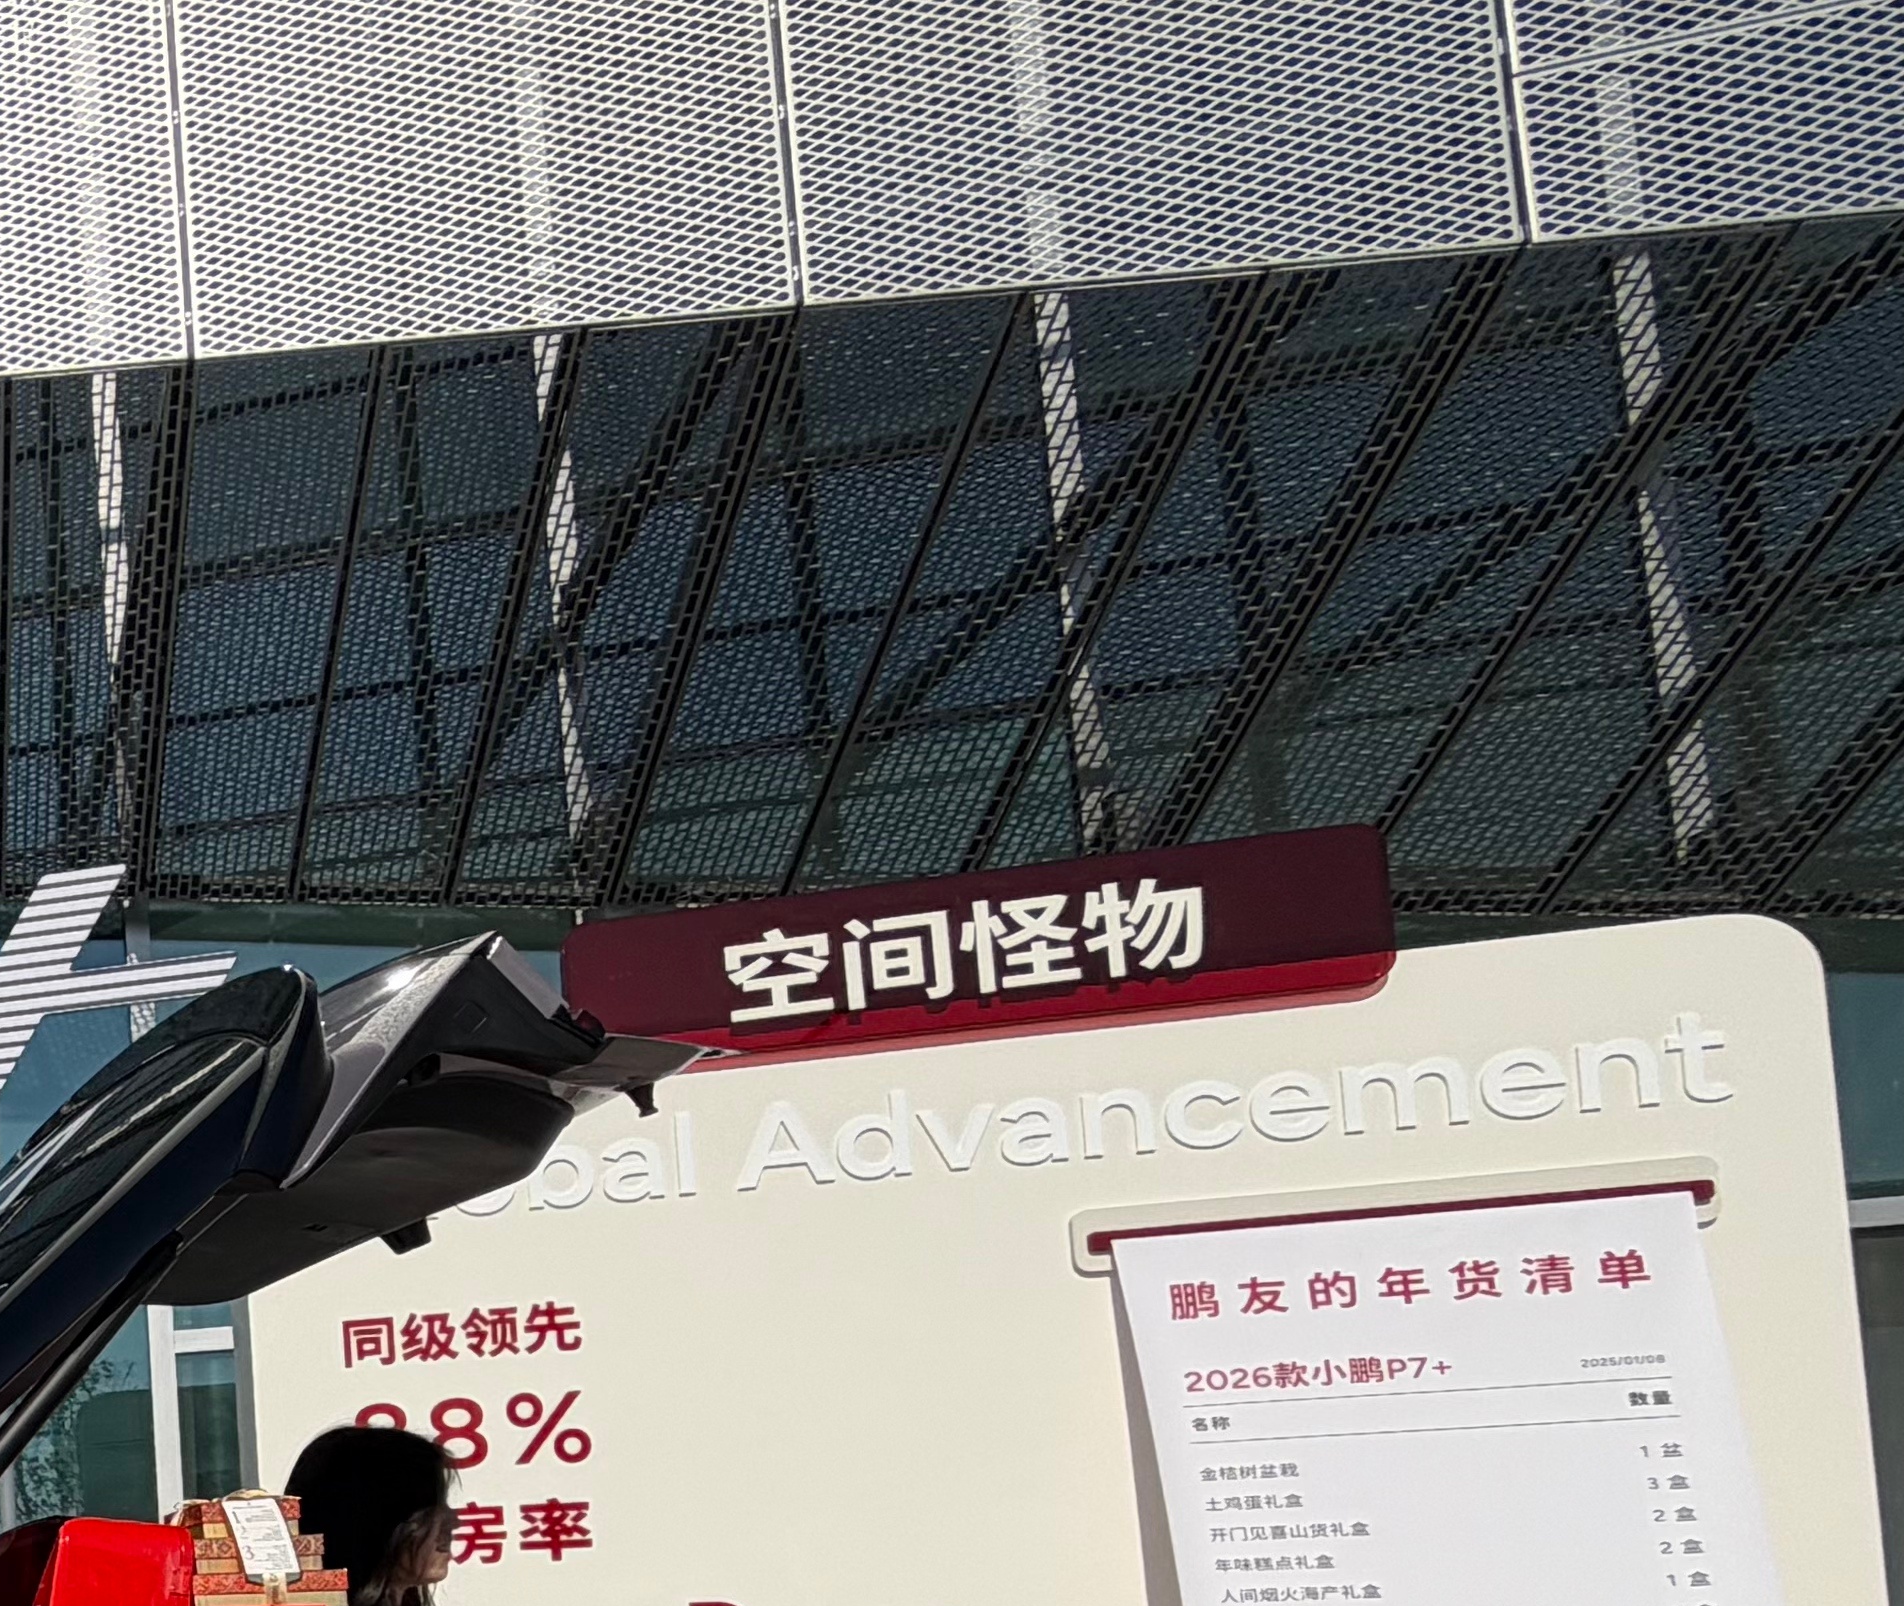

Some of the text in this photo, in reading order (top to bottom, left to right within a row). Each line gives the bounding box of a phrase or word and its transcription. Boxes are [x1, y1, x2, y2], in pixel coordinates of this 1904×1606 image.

[724, 878, 1205, 1026] 空间怪物
[454, 1012, 1734, 1218] bal Advancement
[1168, 1248, 1653, 1322] 鹏友的年货清单
[341, 1300, 583, 1369] 同级领先
[1183, 1356, 1453, 1393] 2026款小鹏P7+
[1191, 1416, 1231, 1432] 名称
[1204, 1493, 1304, 1512] 土鸡蛋礼盒
[1209, 1521, 1372, 1543] 开门见喜山货礼盒
[1214, 1553, 1336, 1572] 年味糕点礼盒
[1221, 1583, 1382, 1604] 人间烟火海产礼盒
